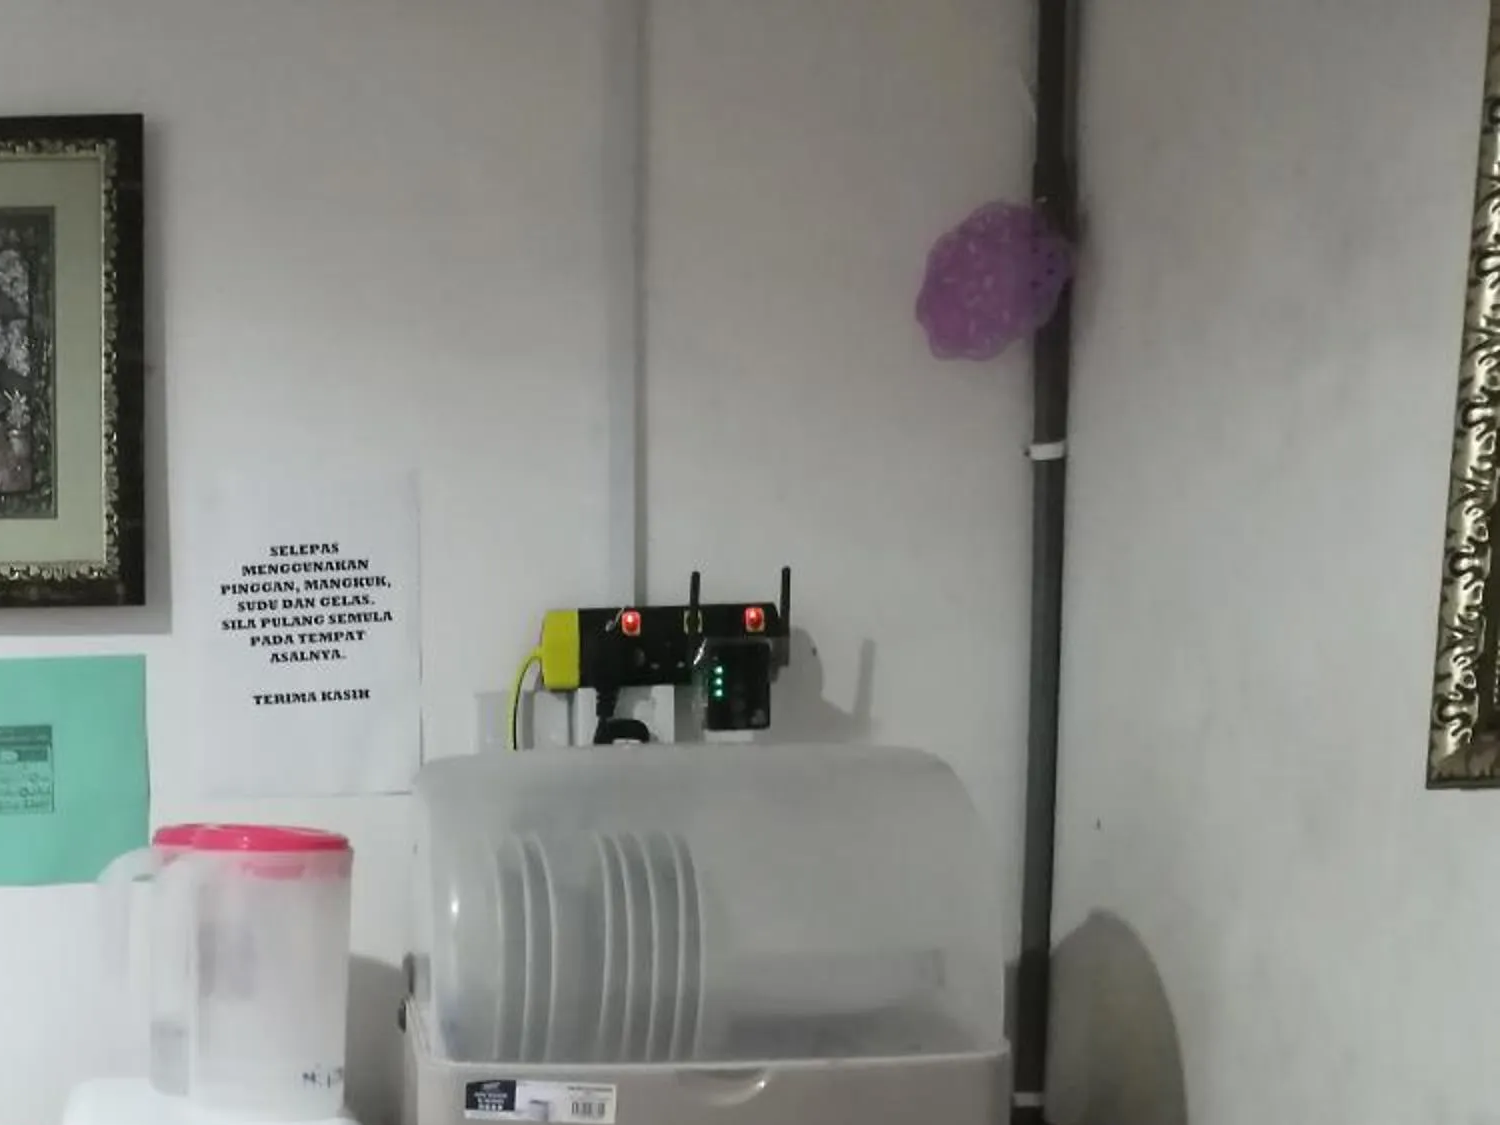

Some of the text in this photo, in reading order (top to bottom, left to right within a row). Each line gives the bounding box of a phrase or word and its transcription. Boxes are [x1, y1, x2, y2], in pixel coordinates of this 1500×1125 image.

[270, 543, 339, 556] SELEPAS
[242, 559, 369, 576] MENGGUNAKAN
[221, 576, 391, 595] PINGGAN, MANGKUK,
[237, 599, 278, 612] SUDU
[283, 597, 315, 610] DAN
[221, 611, 393, 631] SILA PULANG SEMULA
[250, 630, 365, 647] PADA TEMPAT
[270, 649, 346, 663] ASALNYA.
[252, 688, 370, 705] TERIMA KASIH
